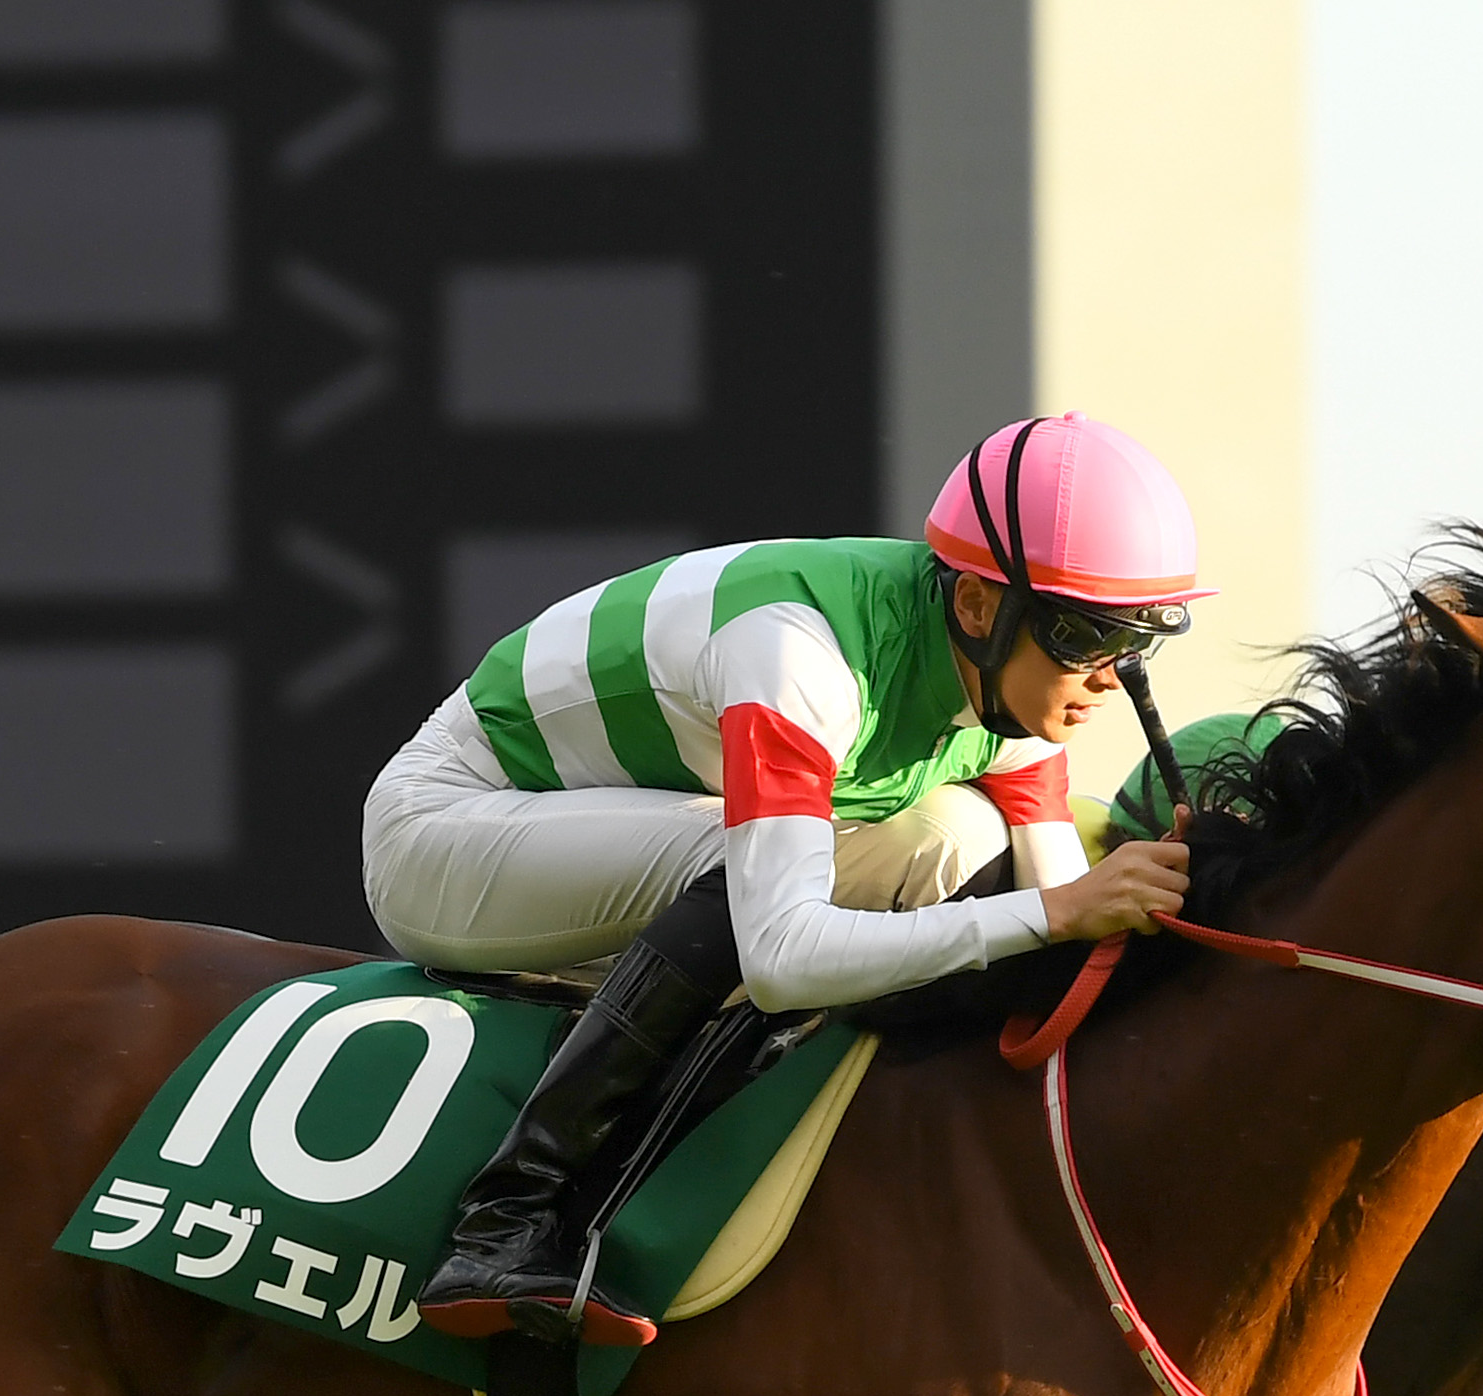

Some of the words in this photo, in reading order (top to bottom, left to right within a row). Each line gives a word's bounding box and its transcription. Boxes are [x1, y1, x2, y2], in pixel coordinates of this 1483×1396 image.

[158, 980, 475, 1203] 10
[89, 1177, 422, 1342] ラヴェル
